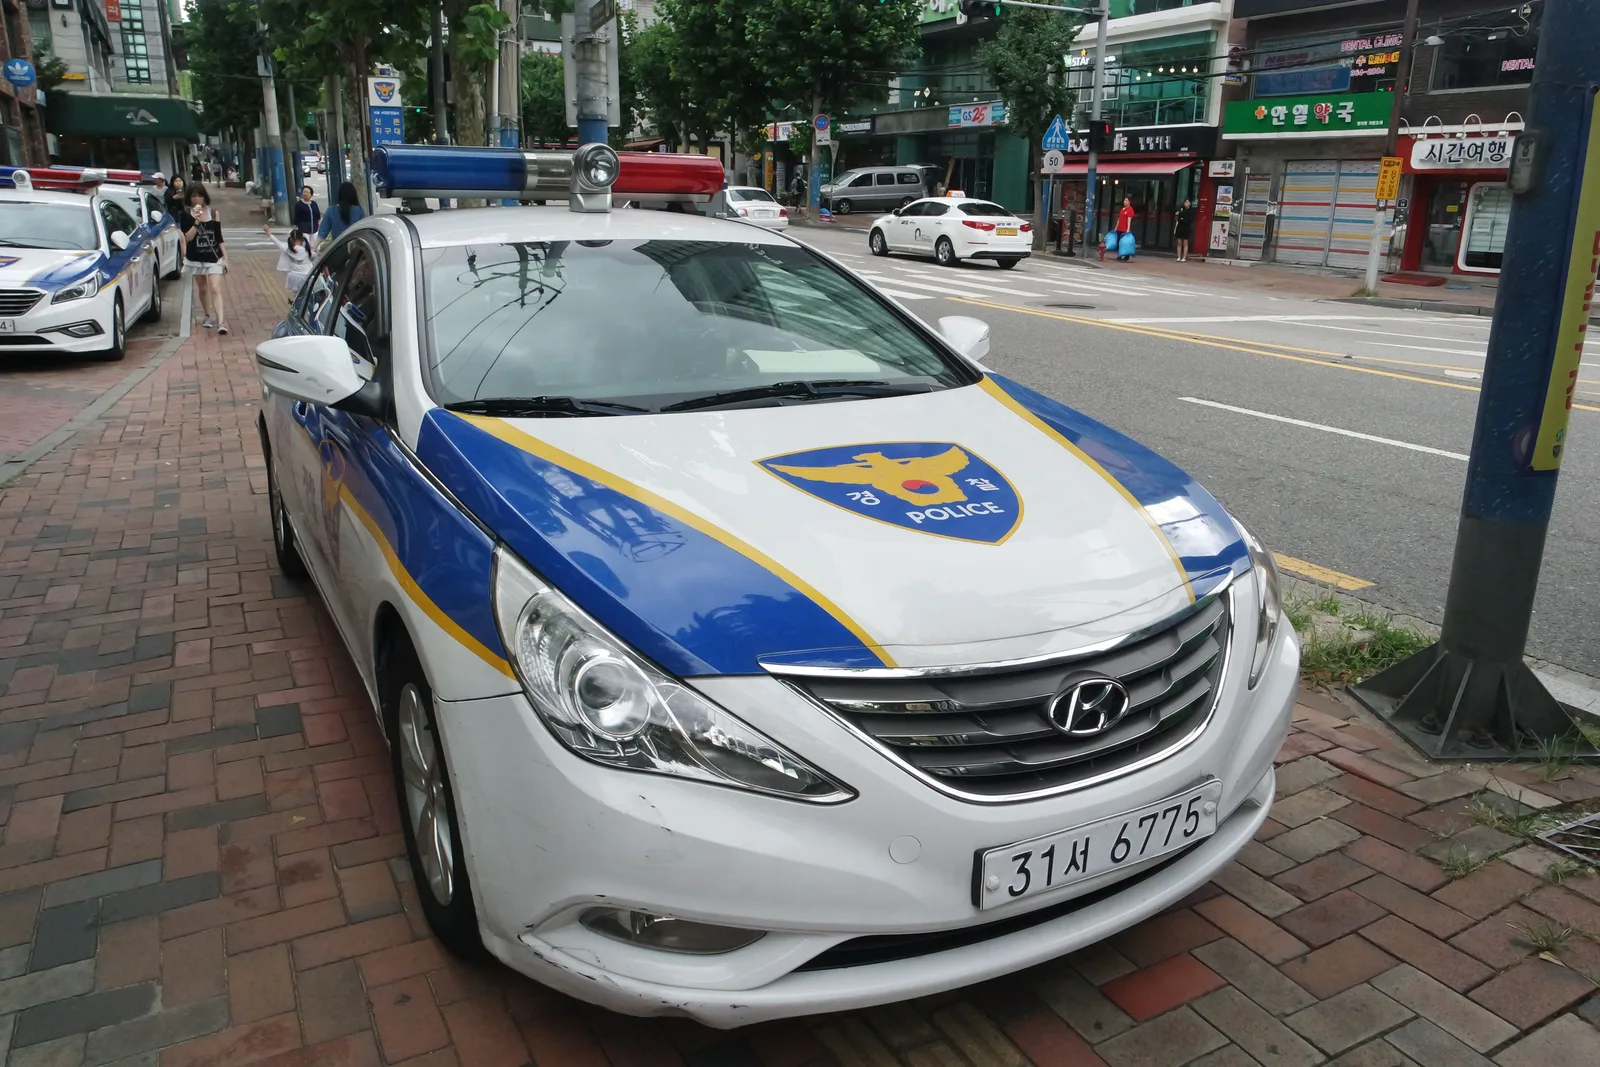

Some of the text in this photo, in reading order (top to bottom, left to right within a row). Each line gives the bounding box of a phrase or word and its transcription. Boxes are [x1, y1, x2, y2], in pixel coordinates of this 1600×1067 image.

[1501, 58, 1536, 71] DENTAL
[1048, 157, 1059, 166] 50
[1424, 140, 1508, 164] 시간여행
[846, 478, 1000, 506] 경 찰
[905, 501, 1005, 524] POLICE
[1008, 795, 1202, 897] 31서 6775
